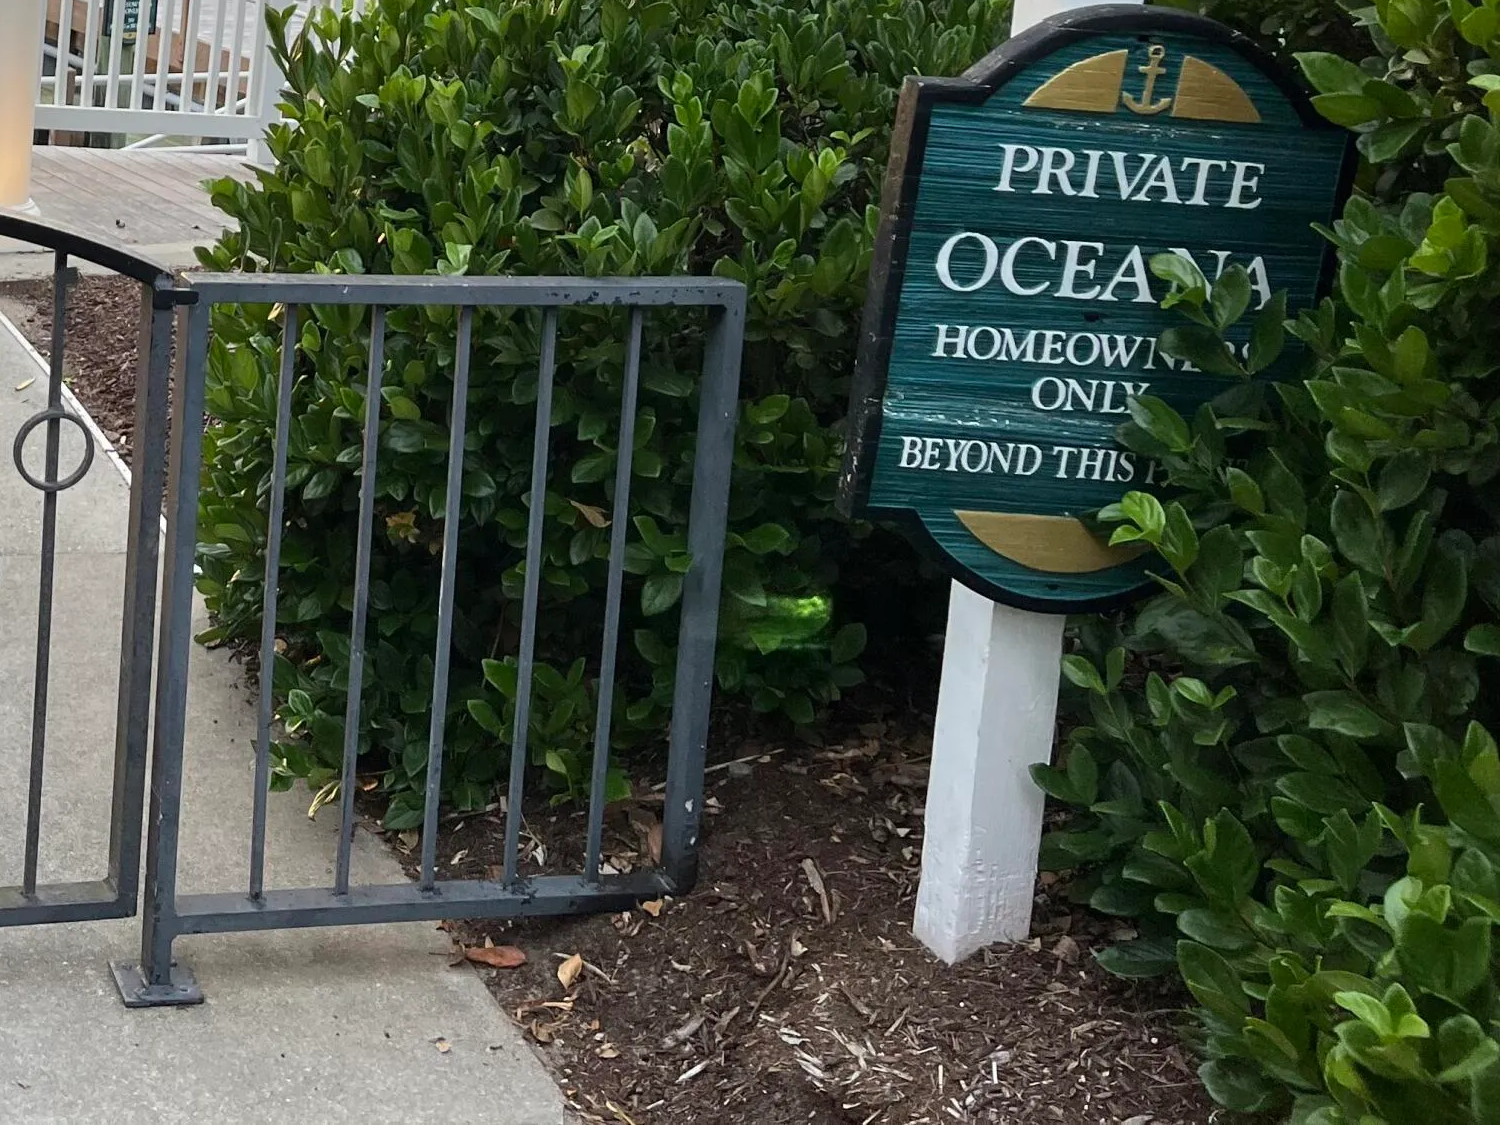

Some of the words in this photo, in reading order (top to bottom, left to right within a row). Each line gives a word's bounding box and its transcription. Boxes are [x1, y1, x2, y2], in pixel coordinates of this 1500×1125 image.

[993, 144, 1266, 210] PRIVATE
[935, 231, 1272, 311] OCEANA
[1031, 377, 1152, 415] ONLY
[899, 436, 1043, 477] BEYOND
[1052, 446, 1136, 483] THIS
